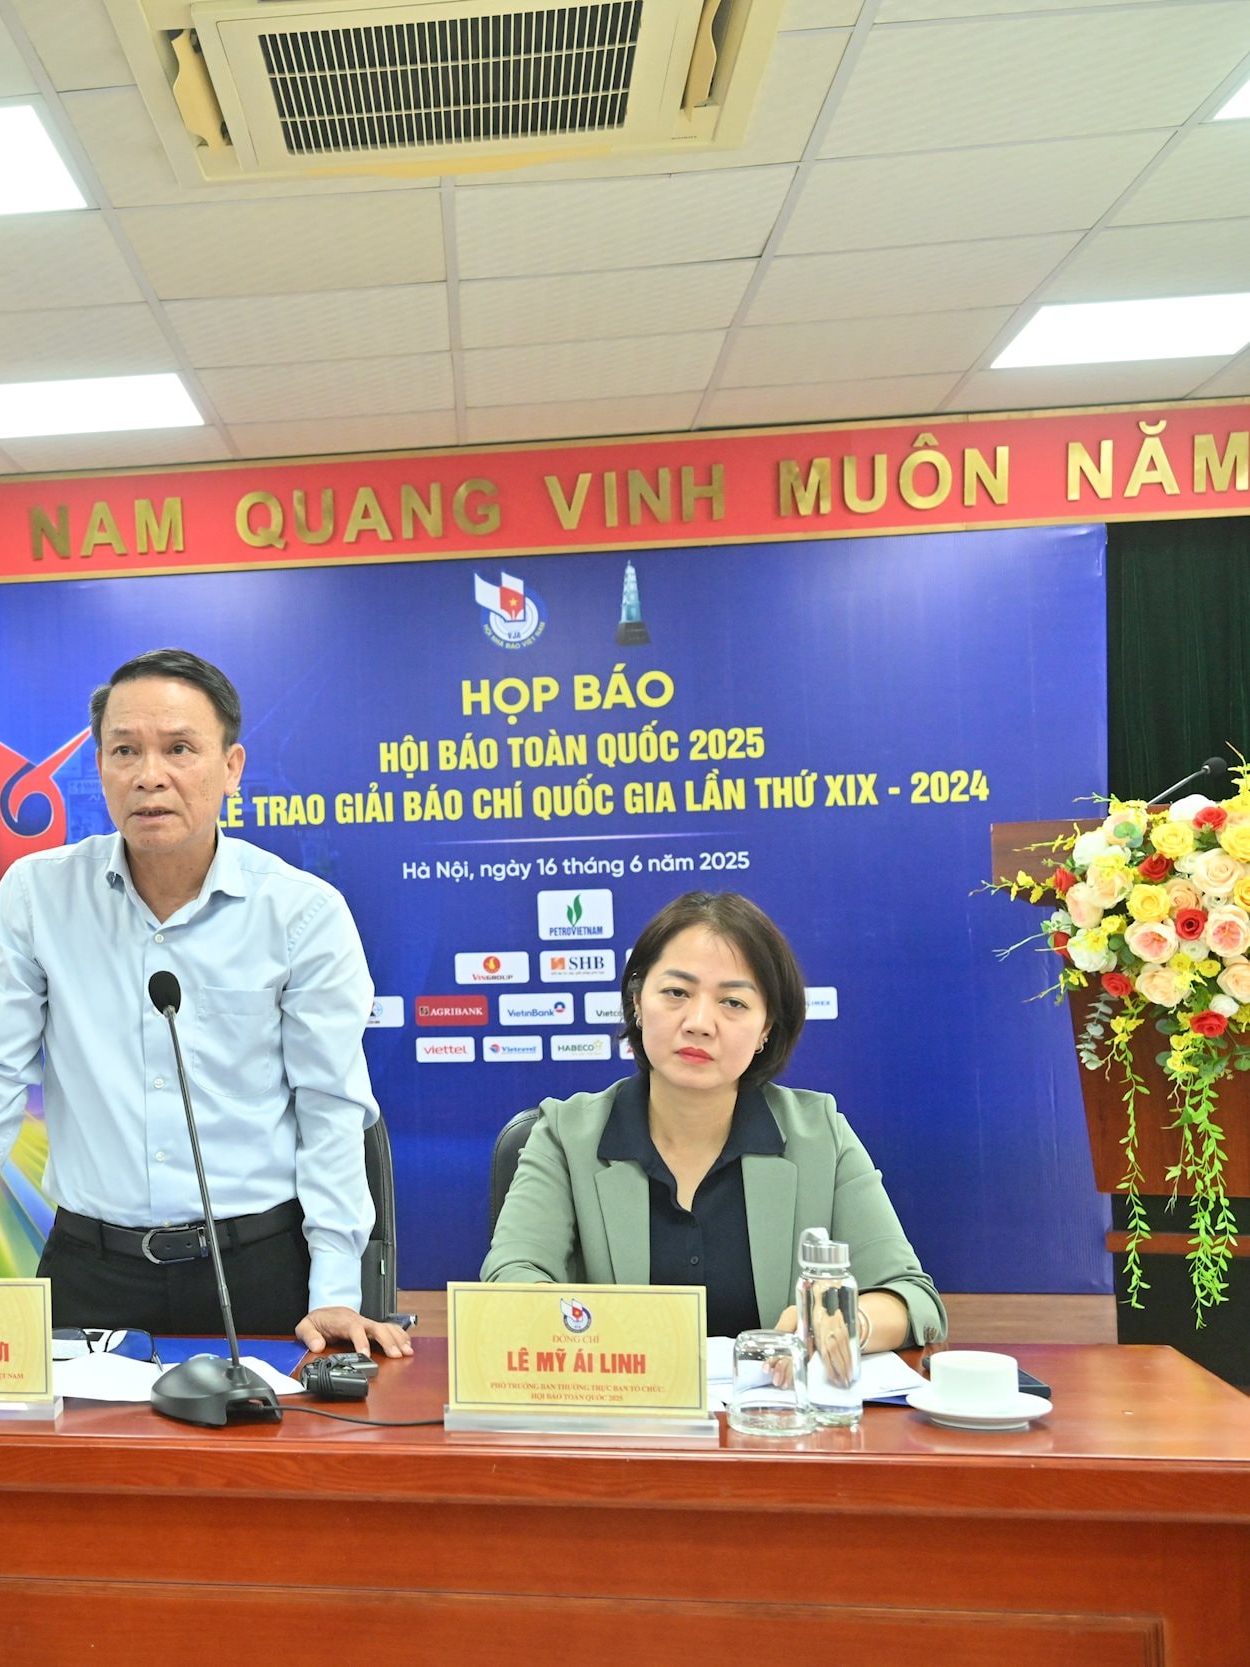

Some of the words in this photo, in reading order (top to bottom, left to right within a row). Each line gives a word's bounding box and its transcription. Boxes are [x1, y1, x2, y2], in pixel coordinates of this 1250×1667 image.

[30, 497, 185, 561] NAM
[235, 479, 502, 551] QUANG
[544, 463, 726, 531] VINH
[778, 432, 1010, 518] MUÔN
[1067, 419, 1250, 502] NĂM
[461, 676, 561, 725] HỌP
[573, 662, 676, 711] BÁO
[379, 734, 430, 779] HỘI
[438, 732, 500, 772] BÁO
[507, 729, 589, 769] TOÀN
[597, 719, 680, 767] QUỐC
[688, 726, 766, 761] 2025
[252, 794, 326, 828] TRAO
[335, 782, 395, 825] GIẢI
[403, 783, 463, 822] BÁO
[472, 780, 524, 820] CHÍ
[532, 773, 615, 821] QUỐC
[623, 781, 677, 814] GIA
[684, 768, 747, 812] LẦN
[754, 769, 819, 809] THỨ
[823, 773, 880, 807] XIX
[888, 784, 901, 796] -
[910, 769, 990, 805] 2024
[402, 861, 431, 880] Hà
[436, 860, 474, 883] Nội,
[480, 859, 532, 881] ngày
[536, 858, 558, 876] 16
[562, 856, 625, 878] tháng
[629, 855, 643, 873] 6
[648, 853, 695, 872] năm
[699, 851, 750, 871] 2025
[549, 926, 604, 936] PETROVIETNAM
[568, 956, 605, 970] SHB
[430, 1006, 483, 1017] AGRIBANK
[507, 1008, 555, 1017] VietinBank
[596, 1009, 623, 1017] Vietco
[423, 1044, 468, 1055] viettel
[507, 1348, 529, 1372] LÊ
[536, 1349, 567, 1372] MỸ
[573, 1349, 594, 1373] ÁI
[600, 1353, 647, 1375] LINH
